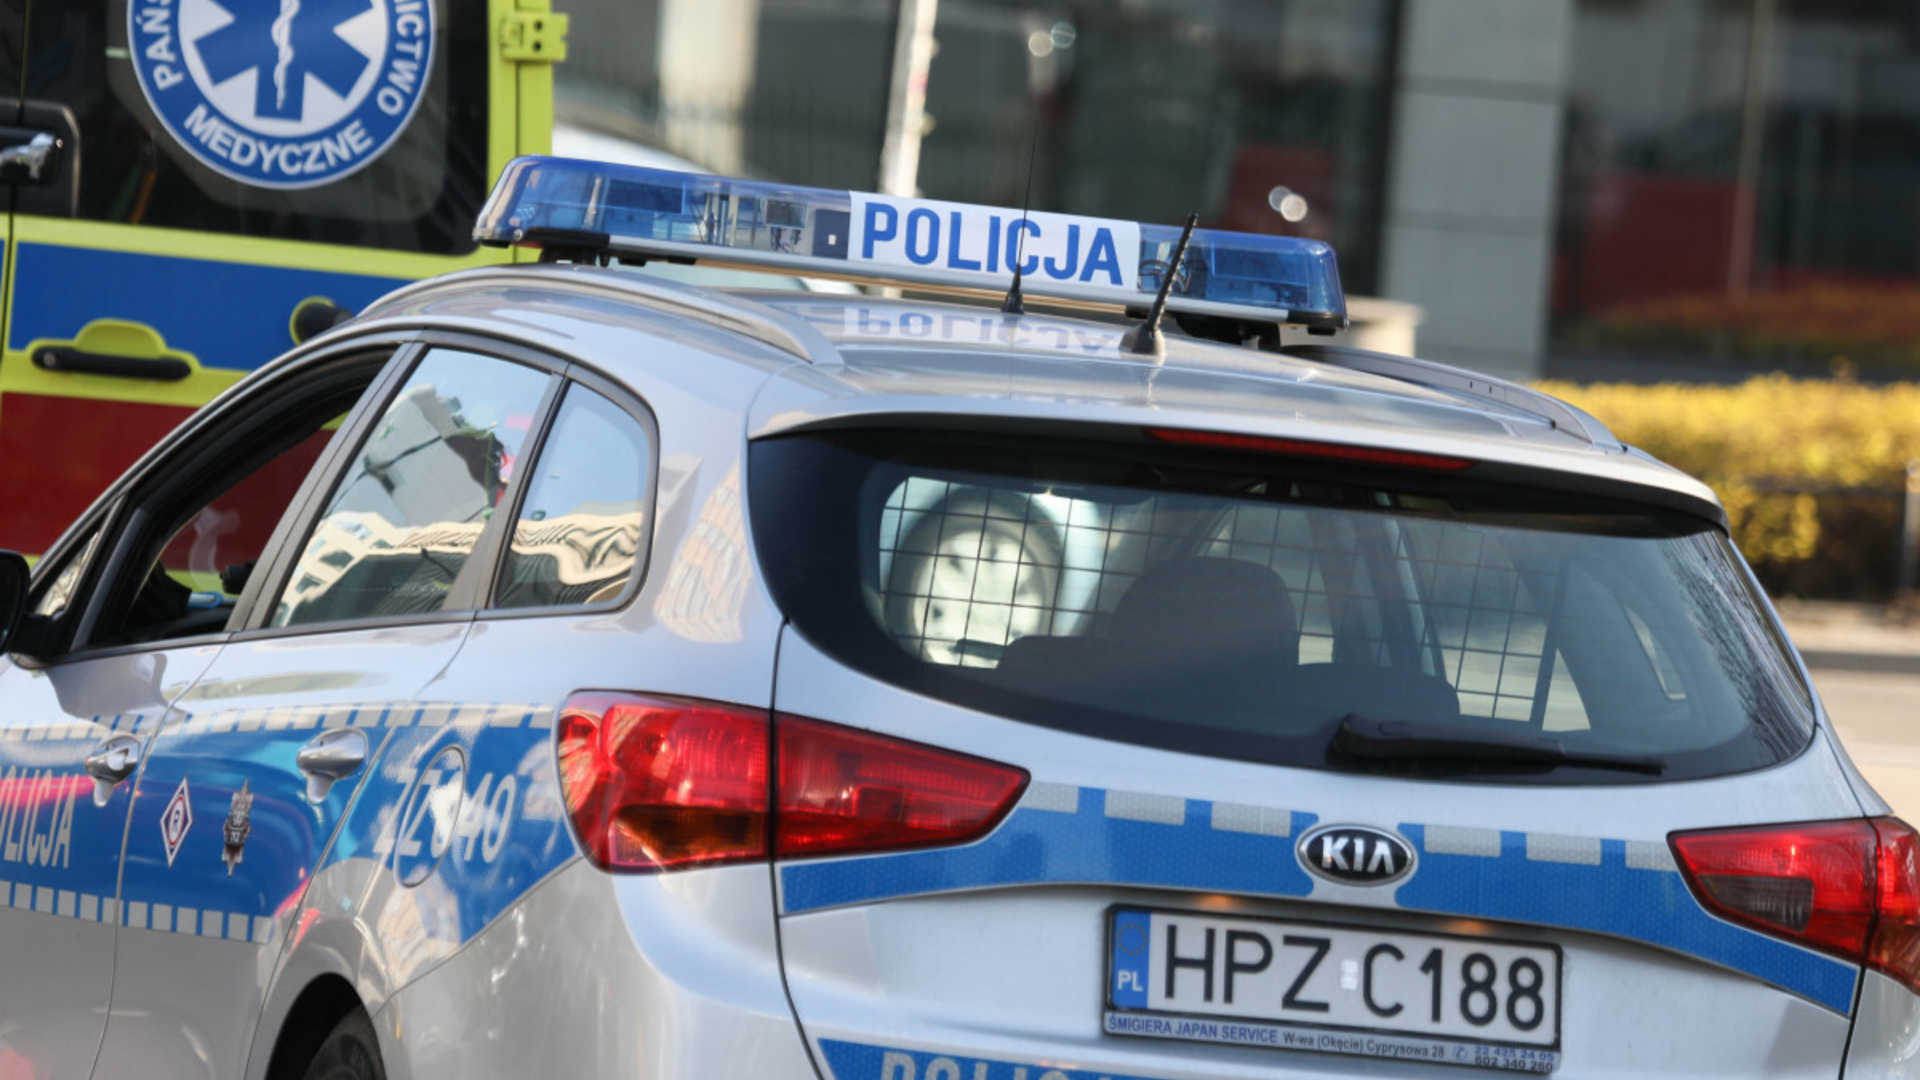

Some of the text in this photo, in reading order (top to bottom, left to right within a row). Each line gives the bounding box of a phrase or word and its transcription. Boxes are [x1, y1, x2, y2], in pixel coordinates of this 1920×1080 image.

[376, 0, 425, 116] ICTWO
[184, 103, 374, 174] MEDYCZNE
[862, 202, 1123, 286] POLICJA
[0, 765, 79, 868] OLICJA
[1321, 836, 1394, 875] KIA
[1117, 971, 1143, 992] PL
[1164, 924, 1544, 1031] HPZ C188
[1109, 1015, 1445, 1058] ŚMIGIERA JAPAN SERVICE W-wa (Okęcie) Cyprysowa 28
[1474, 1044, 1490, 1056] 22
[1474, 1055, 1554, 1073] 602 340 260
